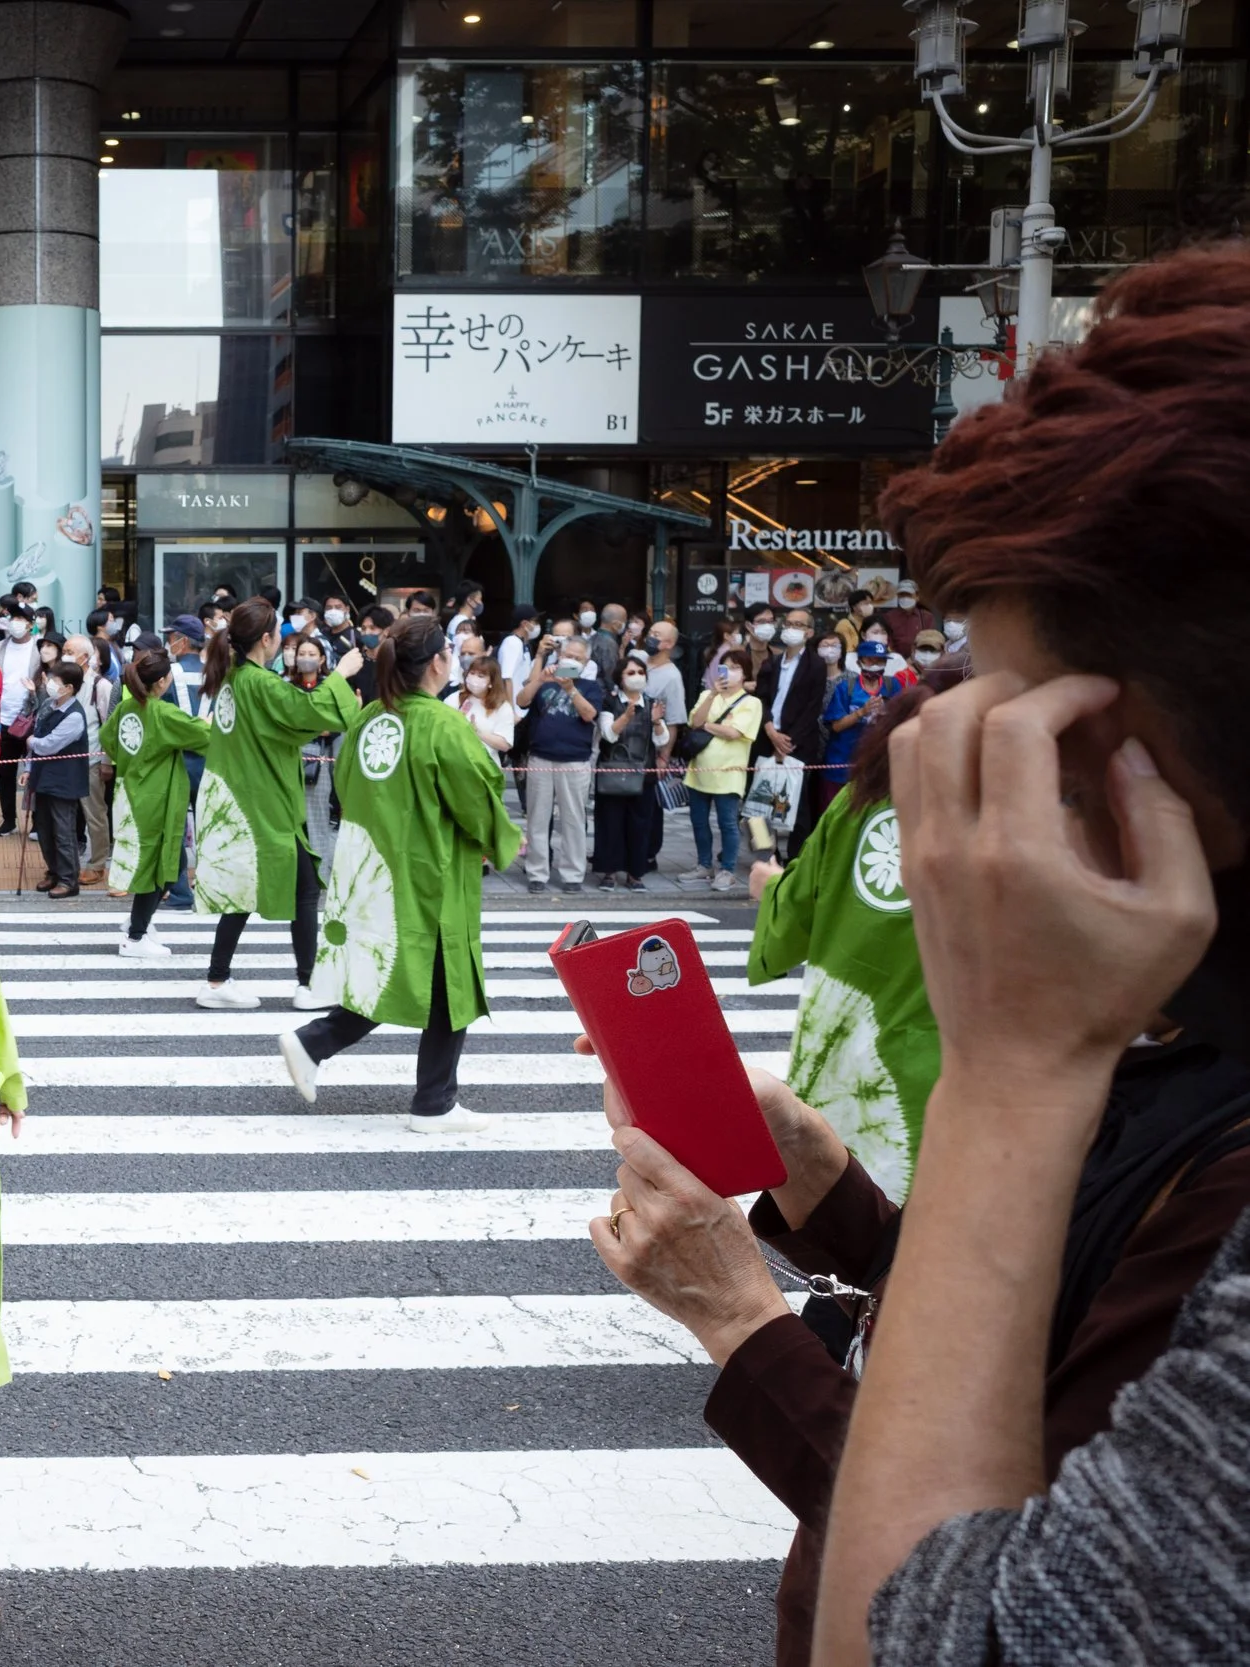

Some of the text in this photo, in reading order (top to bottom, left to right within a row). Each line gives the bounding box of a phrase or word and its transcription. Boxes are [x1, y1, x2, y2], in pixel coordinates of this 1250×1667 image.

[480, 226, 558, 257] AXIS
[745, 322, 834, 340] SAKAE
[476, 412, 548, 428] PANCAKE
[704, 402, 866, 425] 5F 栄ガスホール
[606, 414, 628, 431] B1
[178, 495, 250, 507] TASAKI
